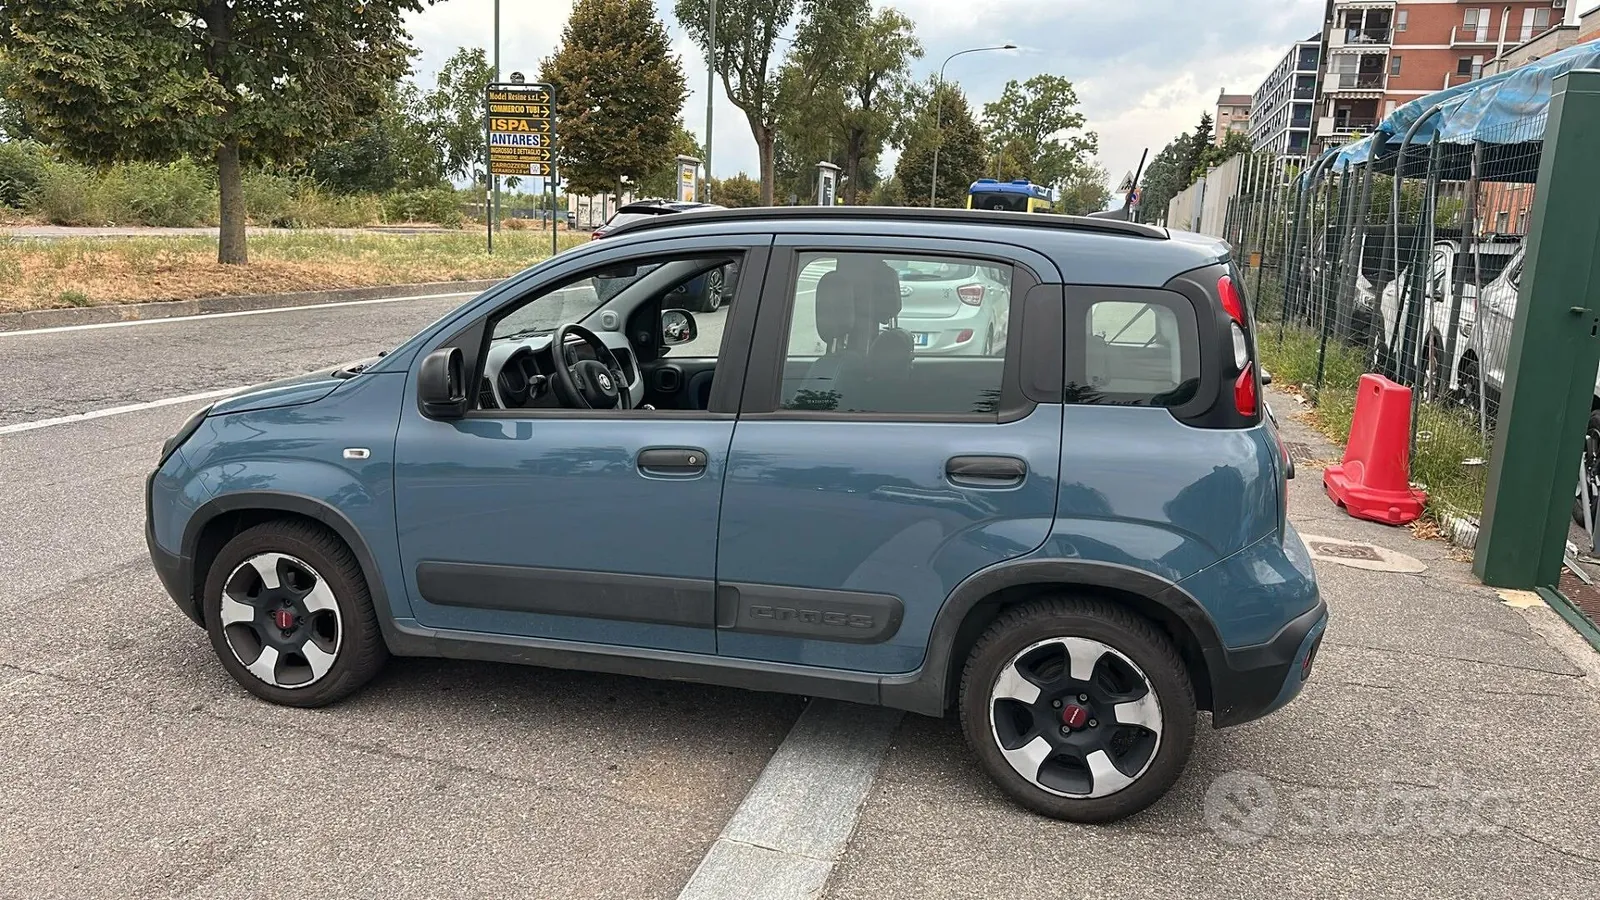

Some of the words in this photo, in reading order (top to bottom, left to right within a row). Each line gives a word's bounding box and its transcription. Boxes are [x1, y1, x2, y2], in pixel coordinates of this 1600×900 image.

[490, 92, 507, 100] Model
[490, 105, 525, 113] COMMERCIO
[526, 105, 540, 114] TUBI
[491, 119, 529, 131] ISPA
[492, 134, 539, 146] ANTARES
